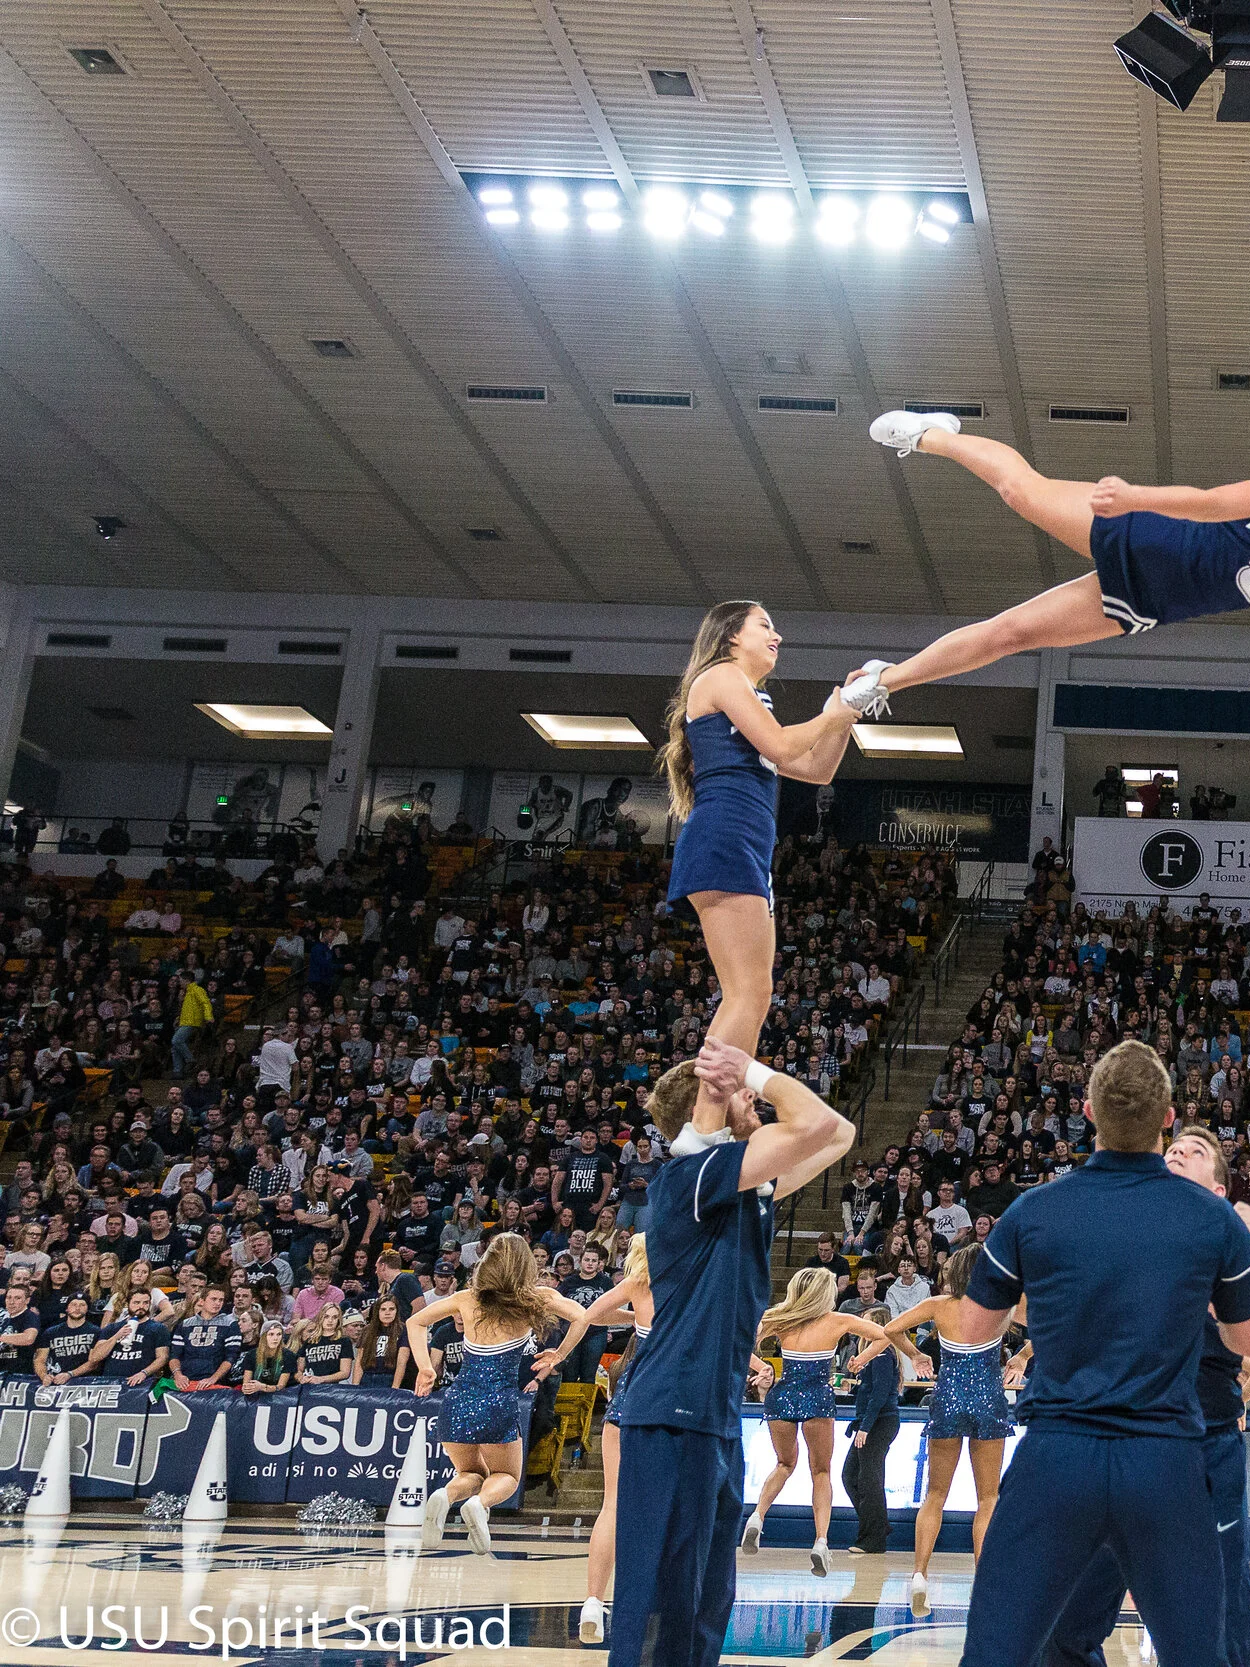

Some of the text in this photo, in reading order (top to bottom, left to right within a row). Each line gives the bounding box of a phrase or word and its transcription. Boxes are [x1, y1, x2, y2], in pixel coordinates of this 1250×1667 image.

[334, 768, 347, 784] J
[972, 792, 1034, 818] STA
[1042, 791, 1053, 806] L
[878, 821, 961, 846] CONSERVICE
[1157, 842, 1186, 877] F
[1208, 870, 1246, 883] Home
[1089, 899, 1113, 908] 2175
[570, 1169, 598, 1179] TRUE
[569, 1179, 595, 1189] BLUE
[317, 1351, 341, 1362] WAY
[34, 1384, 122, 1409] STATE
[253, 1404, 388, 1458] USU
[398, 1493, 424, 1501] STATE
